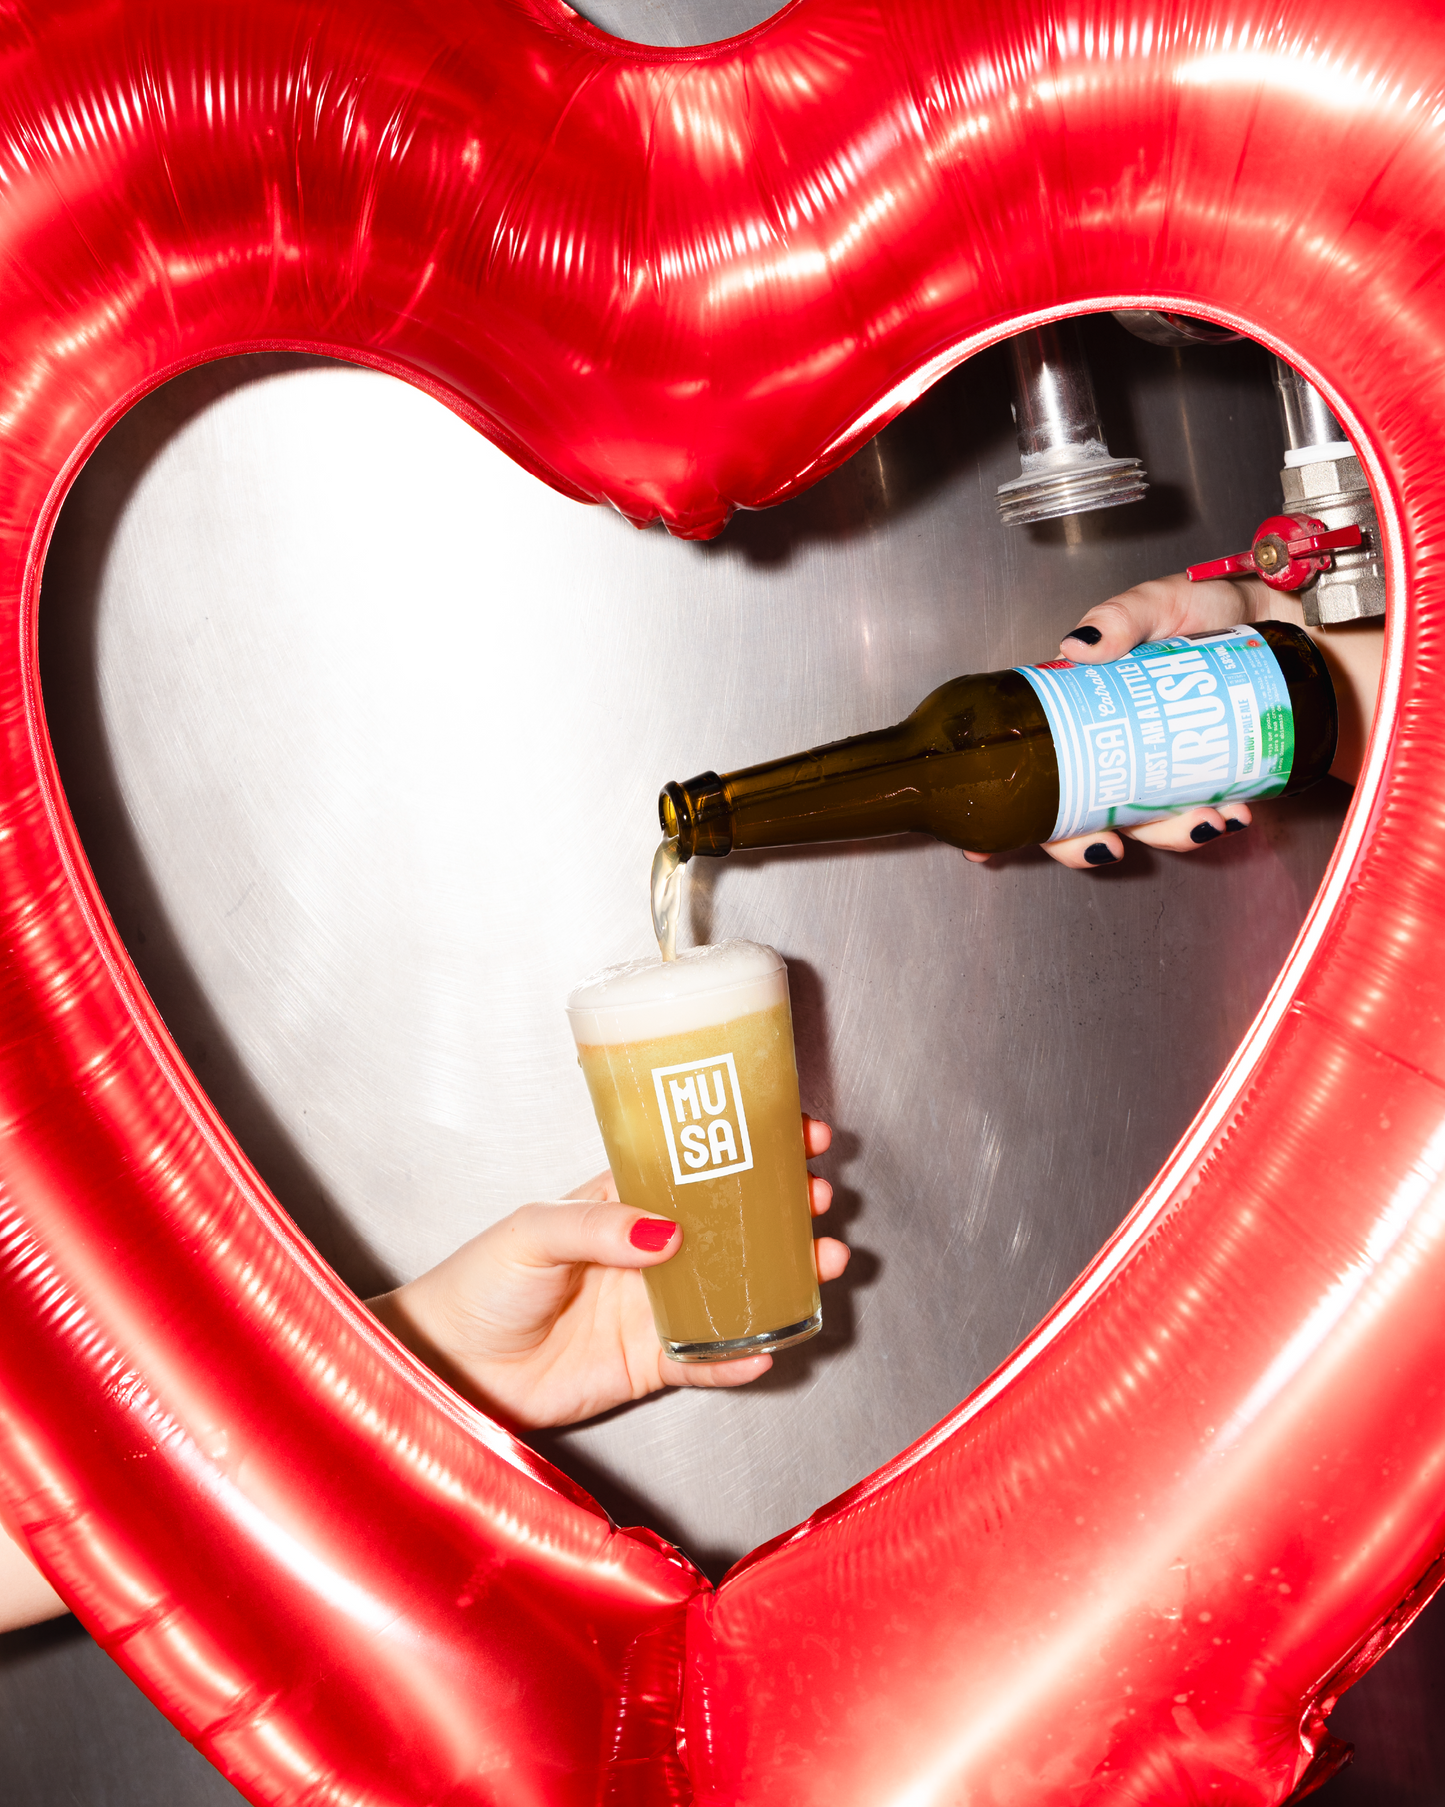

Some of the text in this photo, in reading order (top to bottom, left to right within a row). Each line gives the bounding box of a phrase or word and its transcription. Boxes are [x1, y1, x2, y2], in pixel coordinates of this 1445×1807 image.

[1085, 668, 1116, 718] Catraio
[1116, 662, 1157, 706] LITTLE)
[1137, 706, 1161, 719] A
[1143, 650, 1229, 788] KRUSH
[1238, 698, 1254, 774] FRESH HOP PALE ALE
[1095, 728, 1128, 803] MUSA
